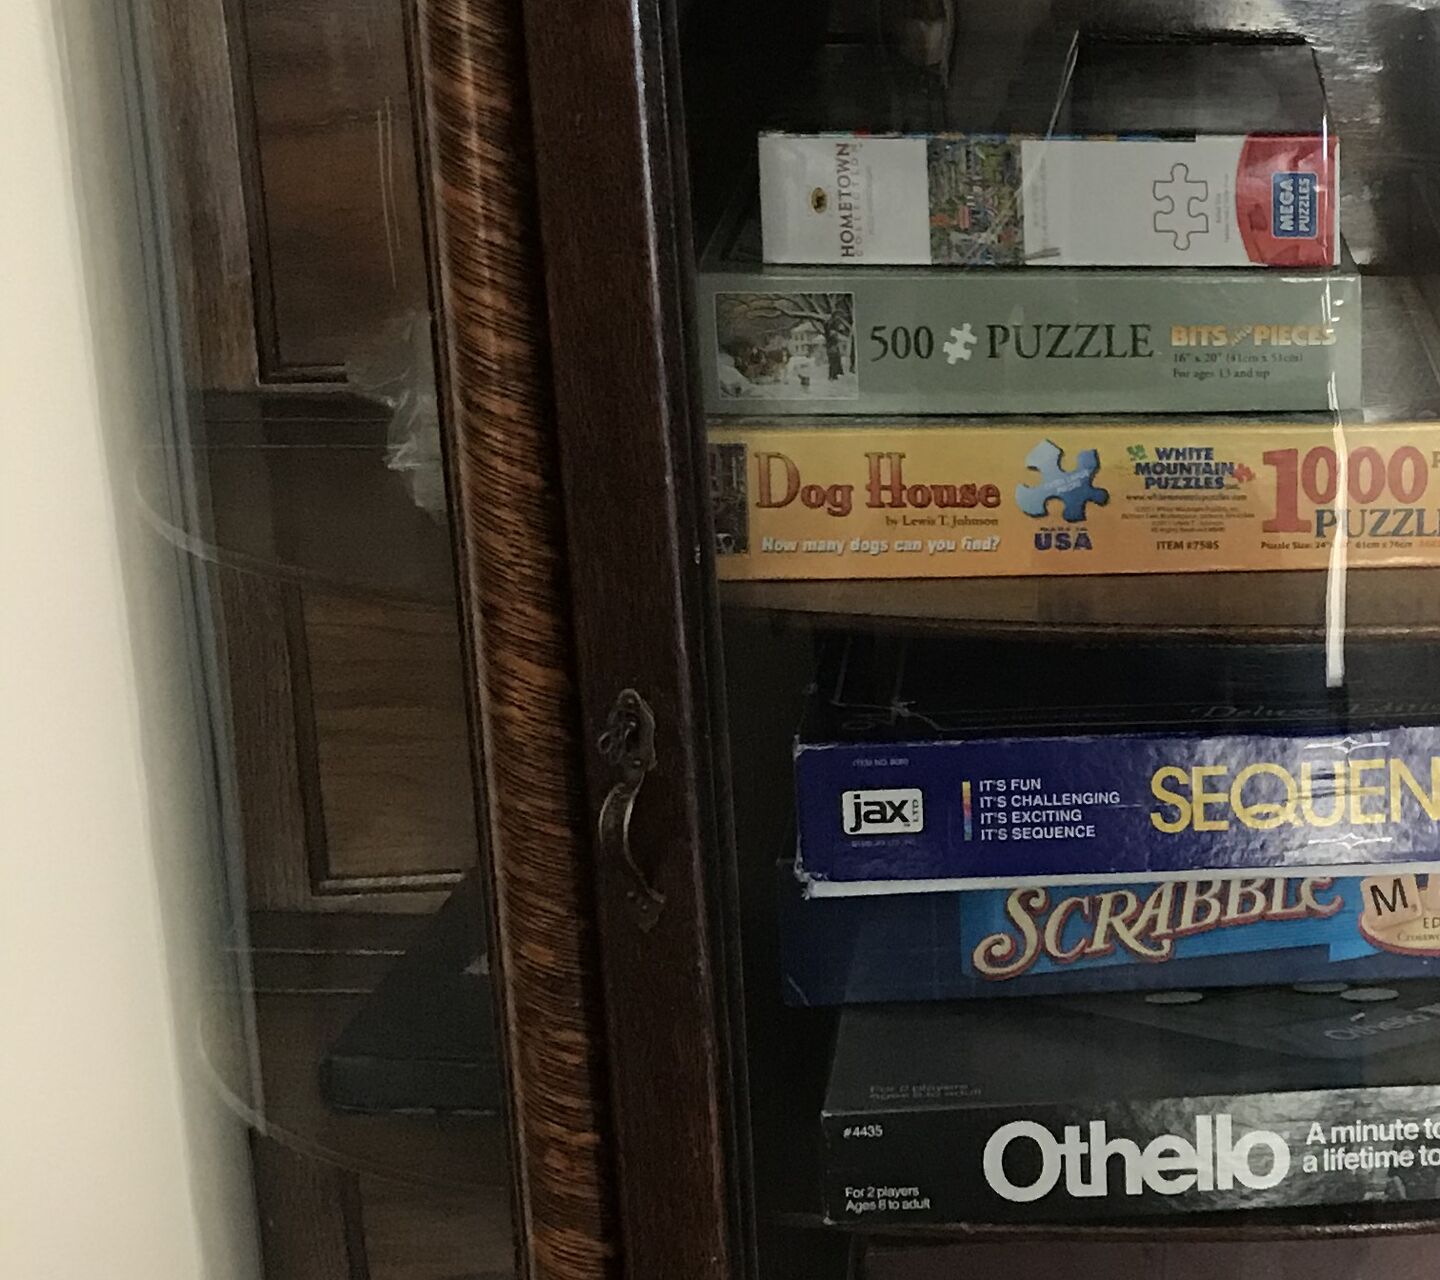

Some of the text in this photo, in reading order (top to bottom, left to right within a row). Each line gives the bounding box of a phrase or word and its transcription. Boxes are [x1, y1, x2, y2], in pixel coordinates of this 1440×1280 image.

[836, 142, 856, 258] HOMETOWN
[1279, 178, 1295, 231] MEGA
[1298, 177, 1311, 232] PUZZLES
[868, 322, 1155, 363] 500 PUZZLE
[1170, 323, 1337, 347] BITS PIECES
[1173, 368, 1191, 379] For
[1194, 370, 1214, 381] ages
[1234, 367, 1253, 378] and
[1256, 369, 1271, 381] up
[1154, 447, 1215, 461] WHITE
[1134, 461, 1235, 476] MOUNTAIN
[753, 451, 1002, 518] Dog House
[1144, 476, 1226, 490] PUZZLES
[1261, 445, 1430, 535] 1000
[885, 514, 899, 528] by
[902, 514, 937, 527] Lewis
[950, 514, 999, 529] Johnson
[761, 535, 1001, 557] How many dogs can you find?
[1034, 531, 1094, 551] USA
[1156, 540, 1184, 551] ITEM
[979, 777, 1042, 793] IT'S FUN
[979, 791, 1122, 809] IT'S CHALLENGING
[849, 793, 911, 833] jax
[980, 809, 1083, 825] IT'S EXCITING
[980, 824, 1096, 841] IT'S SEQUENCE
[971, 876, 1345, 981] SCRABBLE
[843, 1124, 884, 1139] #4435
[1305, 1121, 1327, 1144] A
[1329, 1119, 1418, 1142] minute
[982, 1113, 1292, 1203] Othello
[1302, 1156, 1317, 1173] a
[1321, 1146, 1415, 1171] lifetime
[845, 1185, 920, 1201] For 2 players
[845, 1200, 877, 1213] Ages
[888, 1199, 900, 1210] to
[902, 1197, 931, 1210] adult
